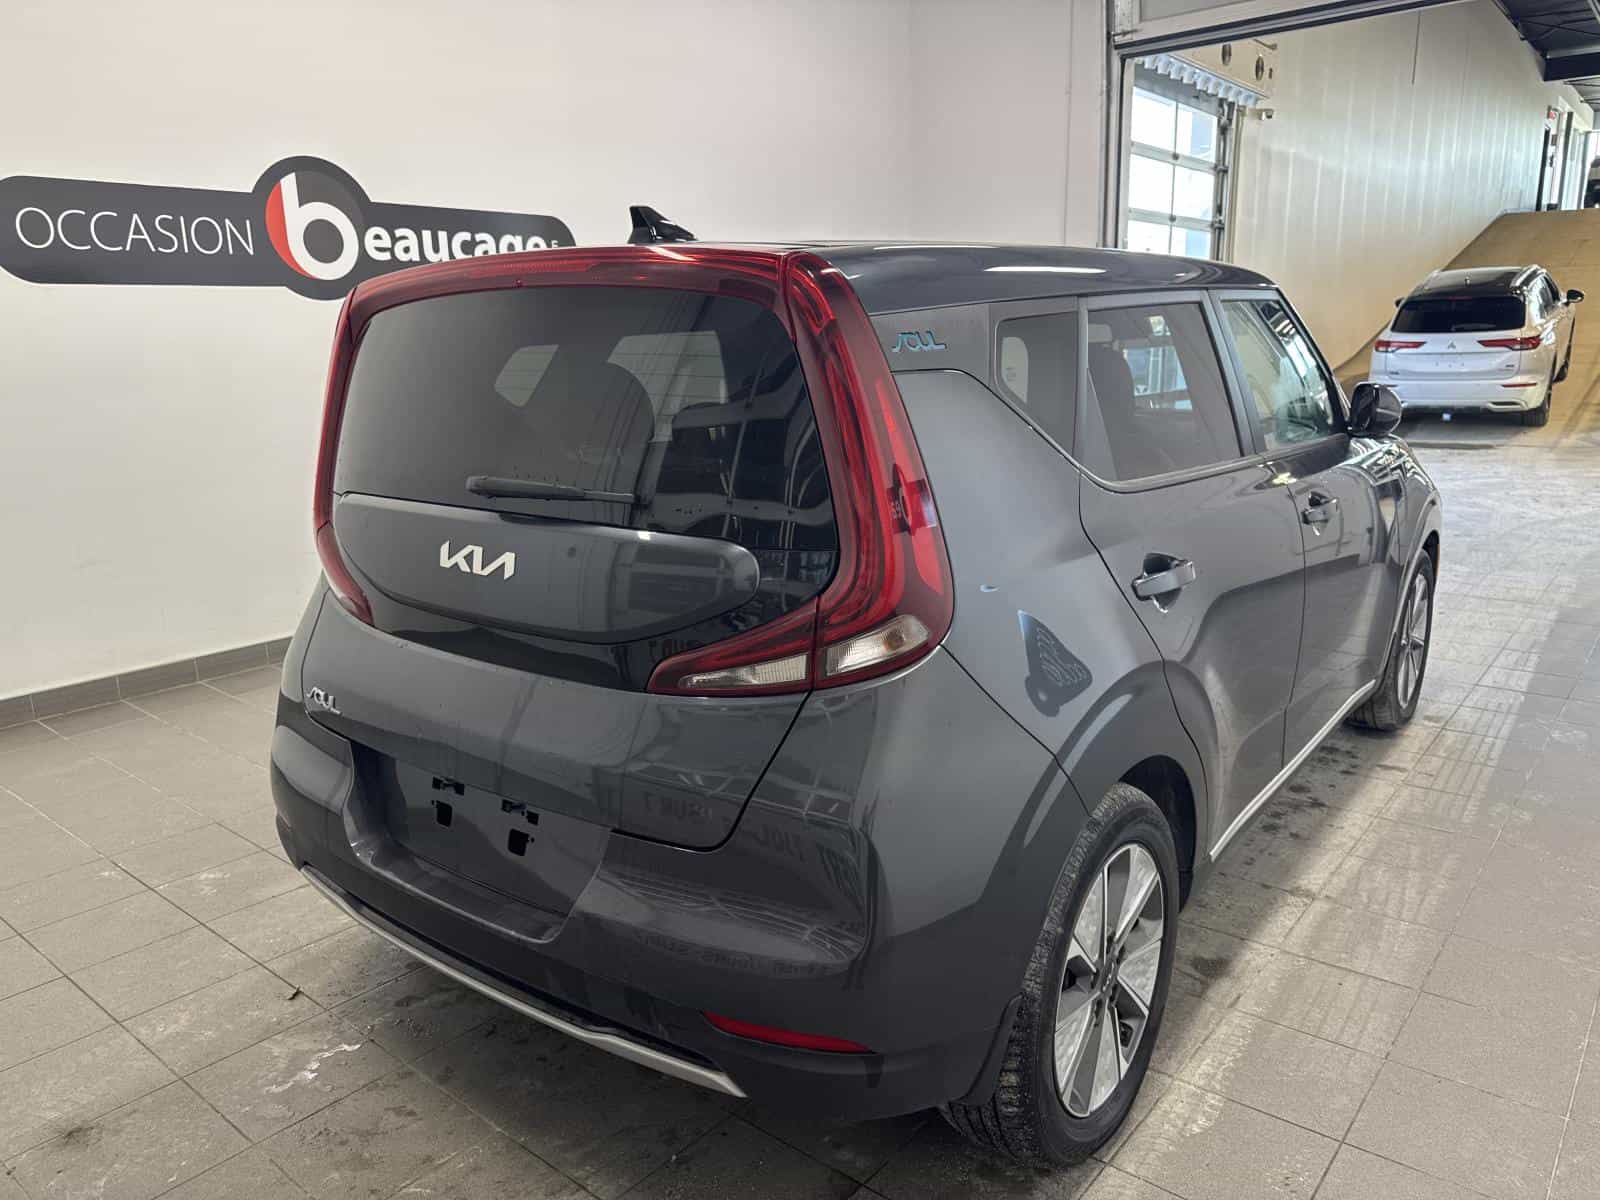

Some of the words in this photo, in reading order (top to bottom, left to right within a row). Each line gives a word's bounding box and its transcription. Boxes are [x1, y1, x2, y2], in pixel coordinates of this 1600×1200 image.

[15, 207, 254, 255] OCCASION
[439, 540, 515, 580] KIA
[306, 686, 341, 714] SOUL
